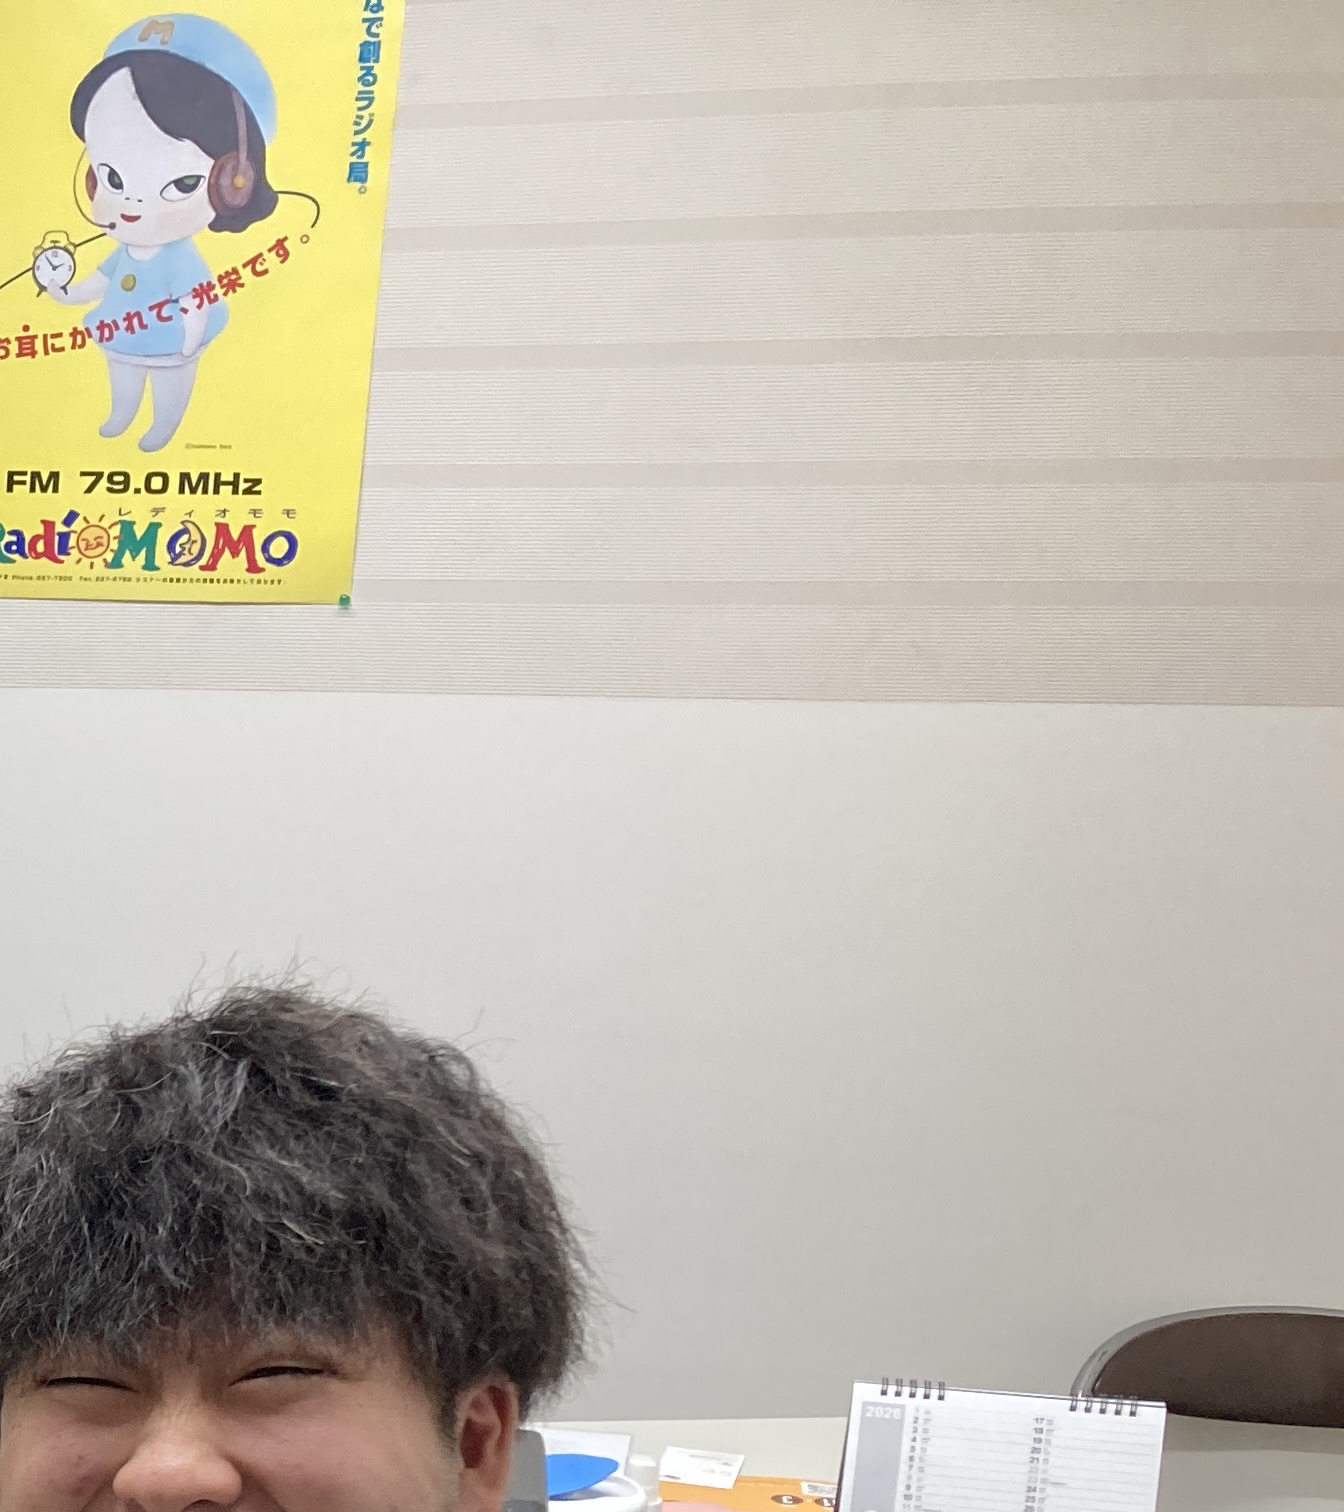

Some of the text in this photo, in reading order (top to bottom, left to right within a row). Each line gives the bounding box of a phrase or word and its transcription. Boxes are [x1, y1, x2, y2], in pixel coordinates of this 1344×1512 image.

[6, 470, 263, 496] FM 79.0 MHz
